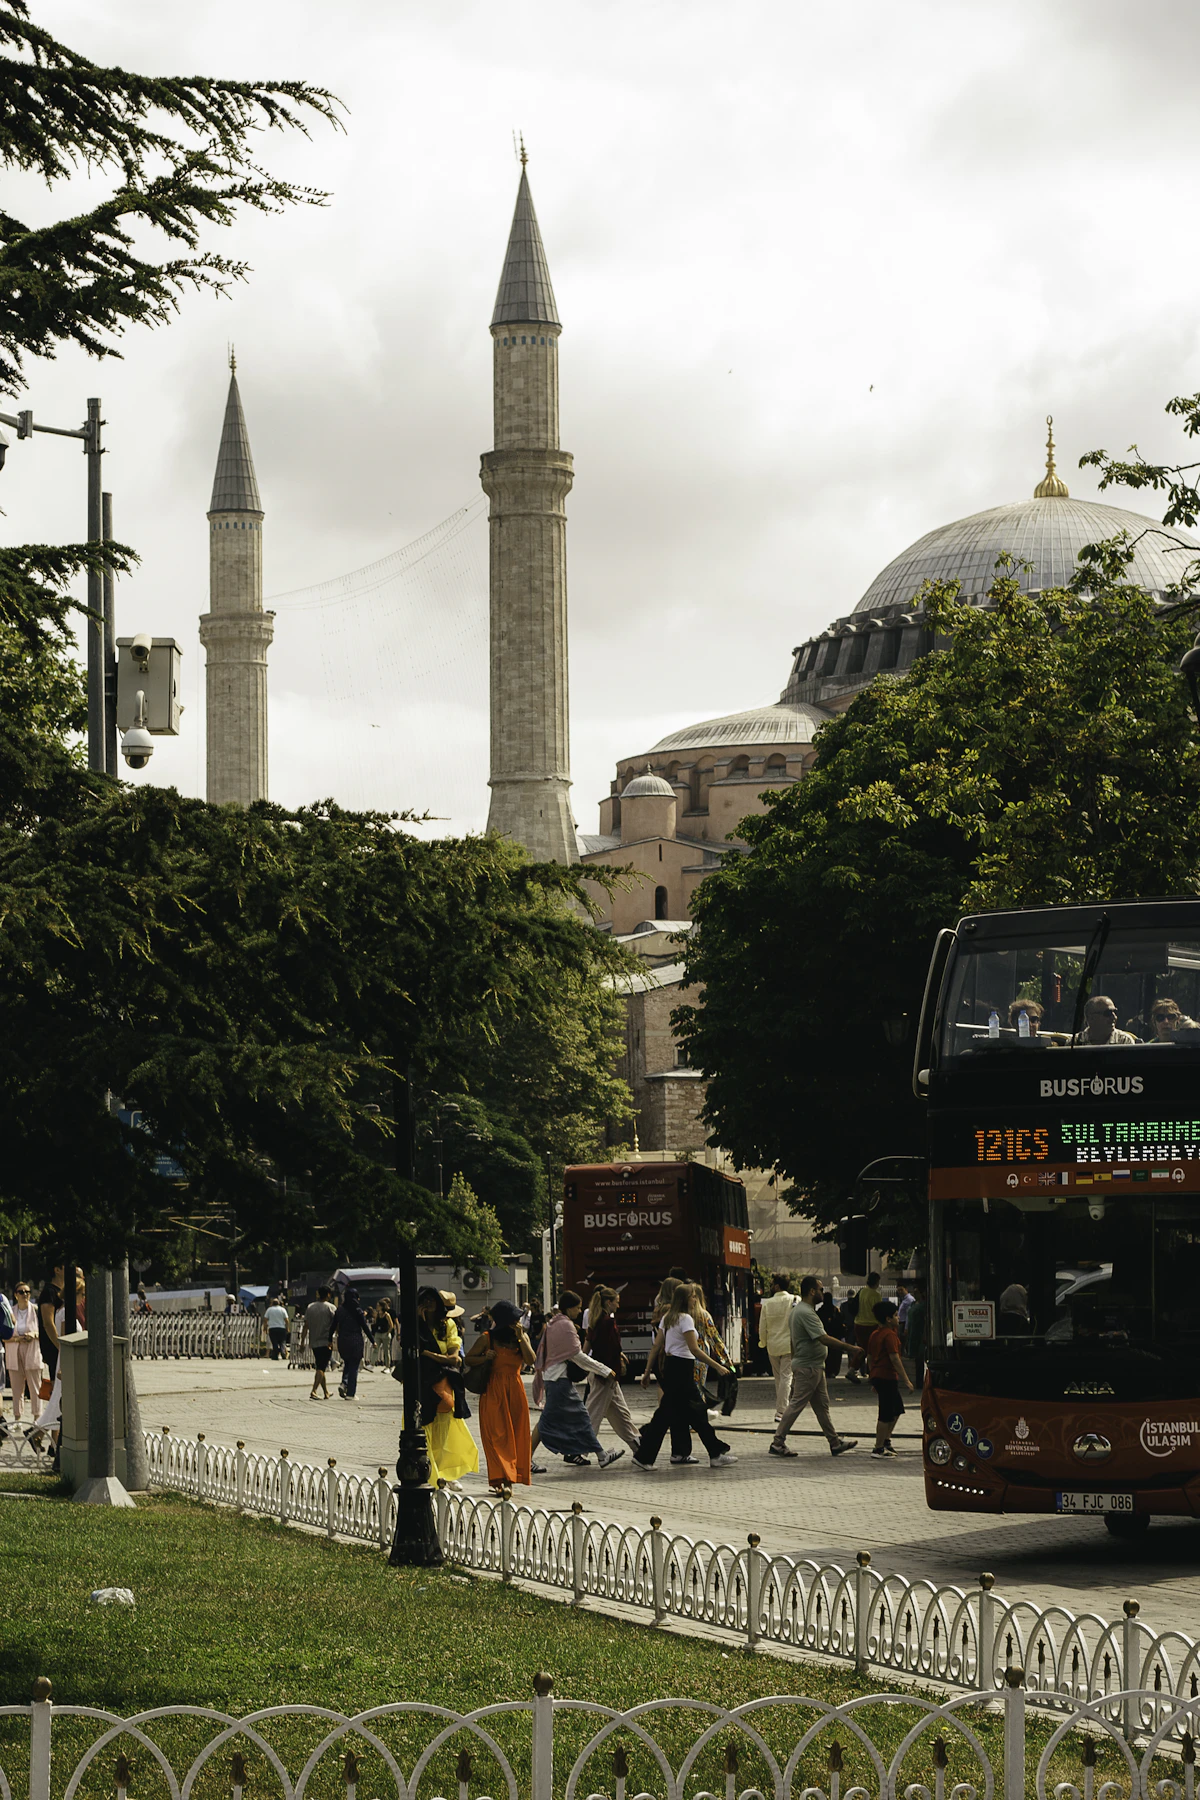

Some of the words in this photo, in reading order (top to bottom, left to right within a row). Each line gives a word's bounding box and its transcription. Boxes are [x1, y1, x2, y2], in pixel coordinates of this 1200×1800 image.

[1040, 1075, 1144, 1097] BUSFORUS
[1076, 1144, 1200, 1163] BEYLERBEY
[584, 1211, 673, 1229] BUSFORUS
[1063, 1381, 1116, 1395] AKIA
[1062, 1494, 1076, 1508] 34
[1083, 1494, 1104, 1508] FJC
[1111, 1495, 1131, 1509] 086
